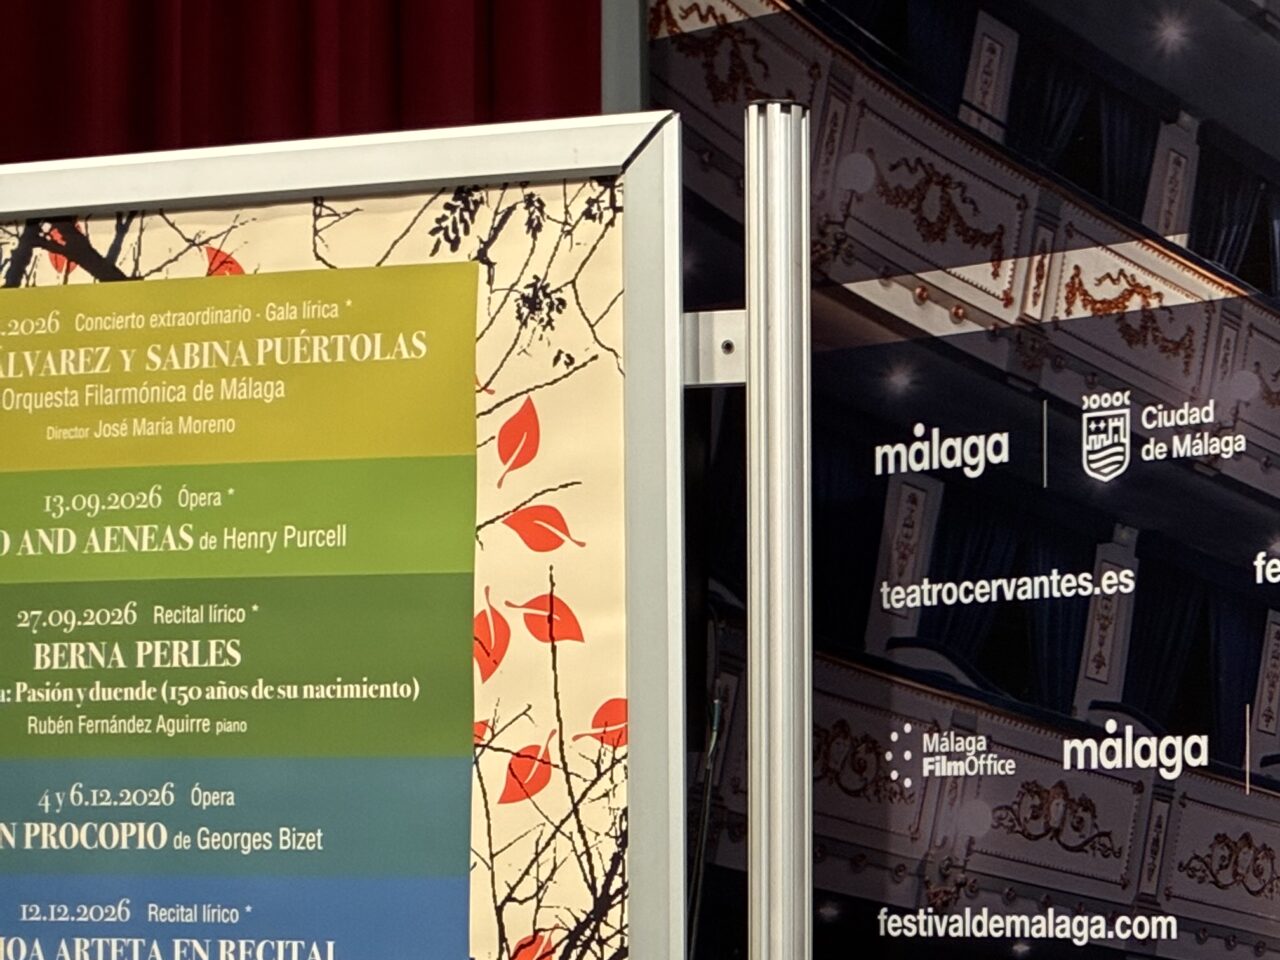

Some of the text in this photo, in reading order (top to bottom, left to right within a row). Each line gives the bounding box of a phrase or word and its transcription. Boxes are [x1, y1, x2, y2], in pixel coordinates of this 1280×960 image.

[75, 312, 145, 333] Concierto
[150, 306, 251, 328] extraordinario
[265, 303, 299, 322] Gala
[302, 300, 339, 319] lírica
[121, 348, 136, 373] Y
[145, 341, 250, 371] SABINA
[257, 329, 427, 367] PUÉRTOLAS
[2, 378, 285, 414] Orquesta Filarmónica de Málaga
[47, 416, 235, 440] Director José María Moreno
[1141, 399, 1214, 430] Ciudad
[1141, 432, 1247, 461] de Málaga
[43, 484, 222, 519] 13.09.2026 Ópera
[16, 527, 77, 556] AND
[83, 523, 194, 553] AENEAS
[199, 532, 217, 551] de
[222, 526, 276, 554] Henry
[283, 524, 347, 548] Purcell
[880, 568, 1135, 610] teatrocervantes.es
[16, 601, 246, 634] 27.09.2026 Recital lírico
[33, 639, 241, 670] BERNA PERLES
[15, 681, 74, 702] Pasión
[76, 687, 88, 708] y
[88, 680, 157, 702] duende
[161, 679, 202, 707] (150
[205, 678, 248, 701] años
[251, 679, 275, 700] de
[276, 683, 300, 700] su
[302, 676, 420, 701] nacimiento)
[27, 714, 248, 736] Rubén Fernández Aguirre piano
[922, 731, 988, 757] Málaga
[922, 754, 1016, 778] FilmOffice
[37, 782, 235, 813] 4 y 6.12.2026 Ópera
[24, 821, 167, 850] PROCOPIO
[173, 830, 192, 850] de
[196, 827, 273, 855] Georges
[278, 826, 324, 851] Bizet
[19, 898, 240, 924] 12.12.2026 Recital lírico
[877, 907, 1177, 946] festivaldemalaga.com
